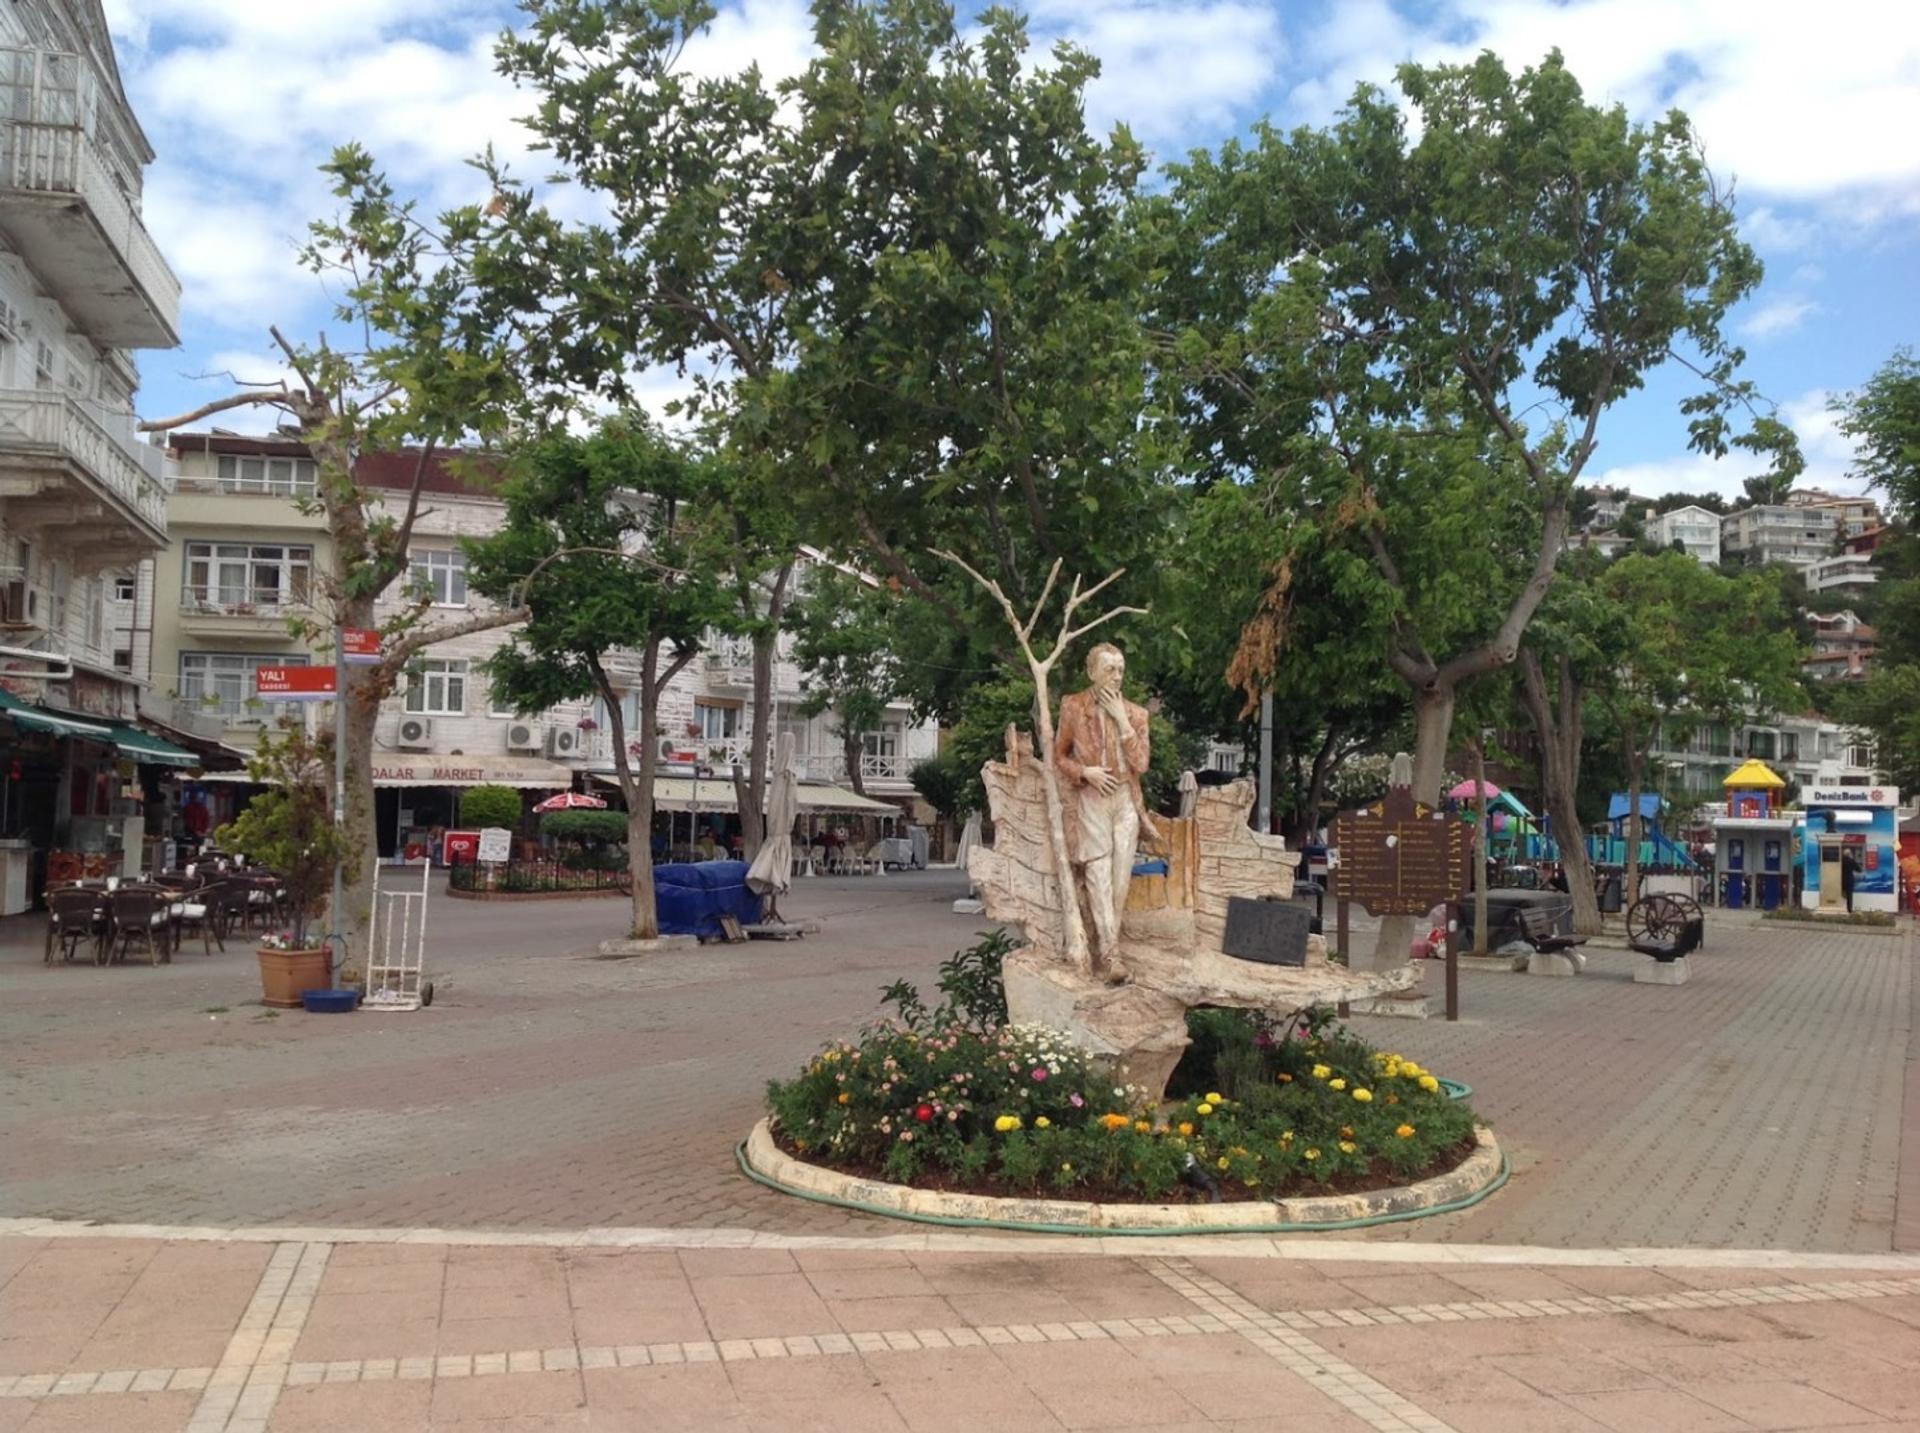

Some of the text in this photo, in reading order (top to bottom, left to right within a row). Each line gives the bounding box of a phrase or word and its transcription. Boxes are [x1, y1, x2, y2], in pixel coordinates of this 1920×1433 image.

[259, 670, 285, 681] YALI
[432, 767, 484, 780] MARKET
[1814, 791, 1868, 801] DenizBank
